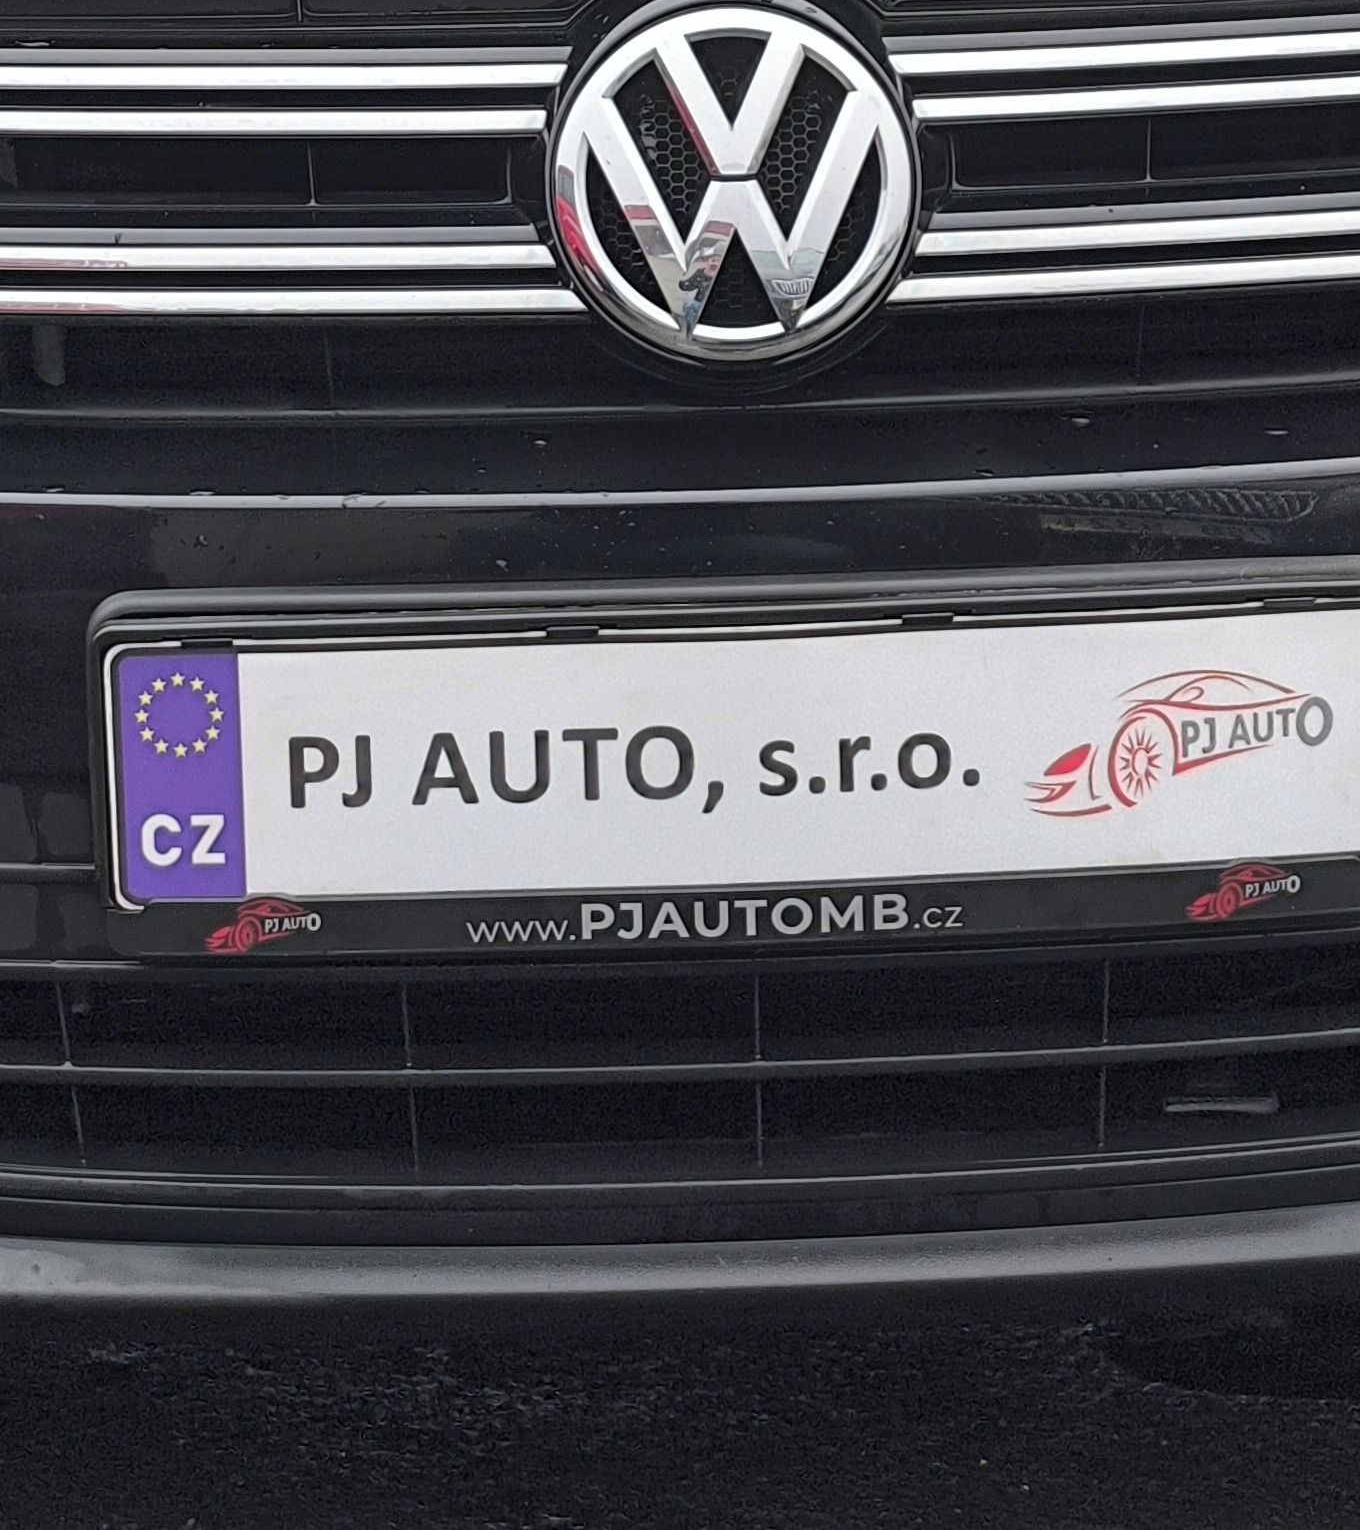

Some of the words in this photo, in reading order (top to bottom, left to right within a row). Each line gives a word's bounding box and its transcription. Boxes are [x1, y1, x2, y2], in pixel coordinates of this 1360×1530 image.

[555, 5, 913, 342] VW
[1181, 717, 1217, 759] PJ
[1228, 696, 1333, 751] AUTO
[288, 734, 372, 808] PJ
[412, 725, 725, 814] AUTO,
[757, 732, 981, 796] s.r.o.
[141, 813, 227, 866] CZ
[1244, 882, 1260, 898] PJ
[1262, 875, 1301, 894] AUTO
[264, 917, 280, 933] PJ
[282, 912, 322, 932] AUTO
[466, 893, 965, 943] www.PJAUTOMB.cz
